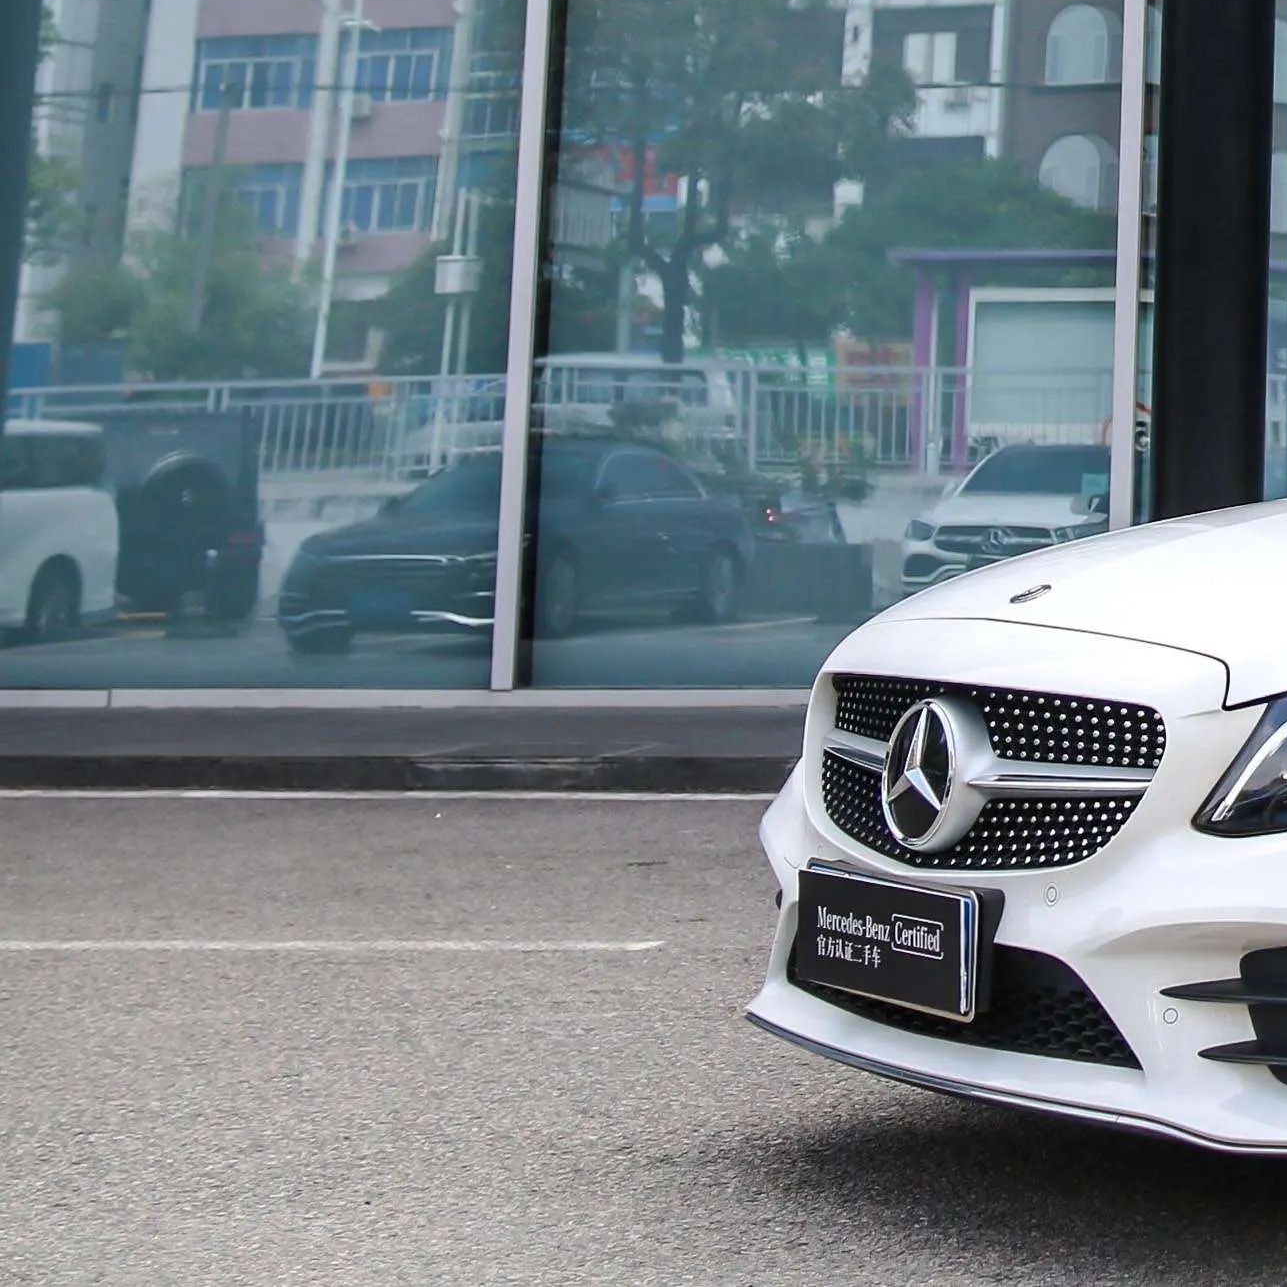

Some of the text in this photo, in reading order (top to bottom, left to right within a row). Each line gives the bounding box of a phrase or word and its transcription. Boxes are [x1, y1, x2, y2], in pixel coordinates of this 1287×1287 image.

[817, 905, 941, 953] Mercedes-Benz Certified
[816, 934, 882, 968] 官方认证二手车
